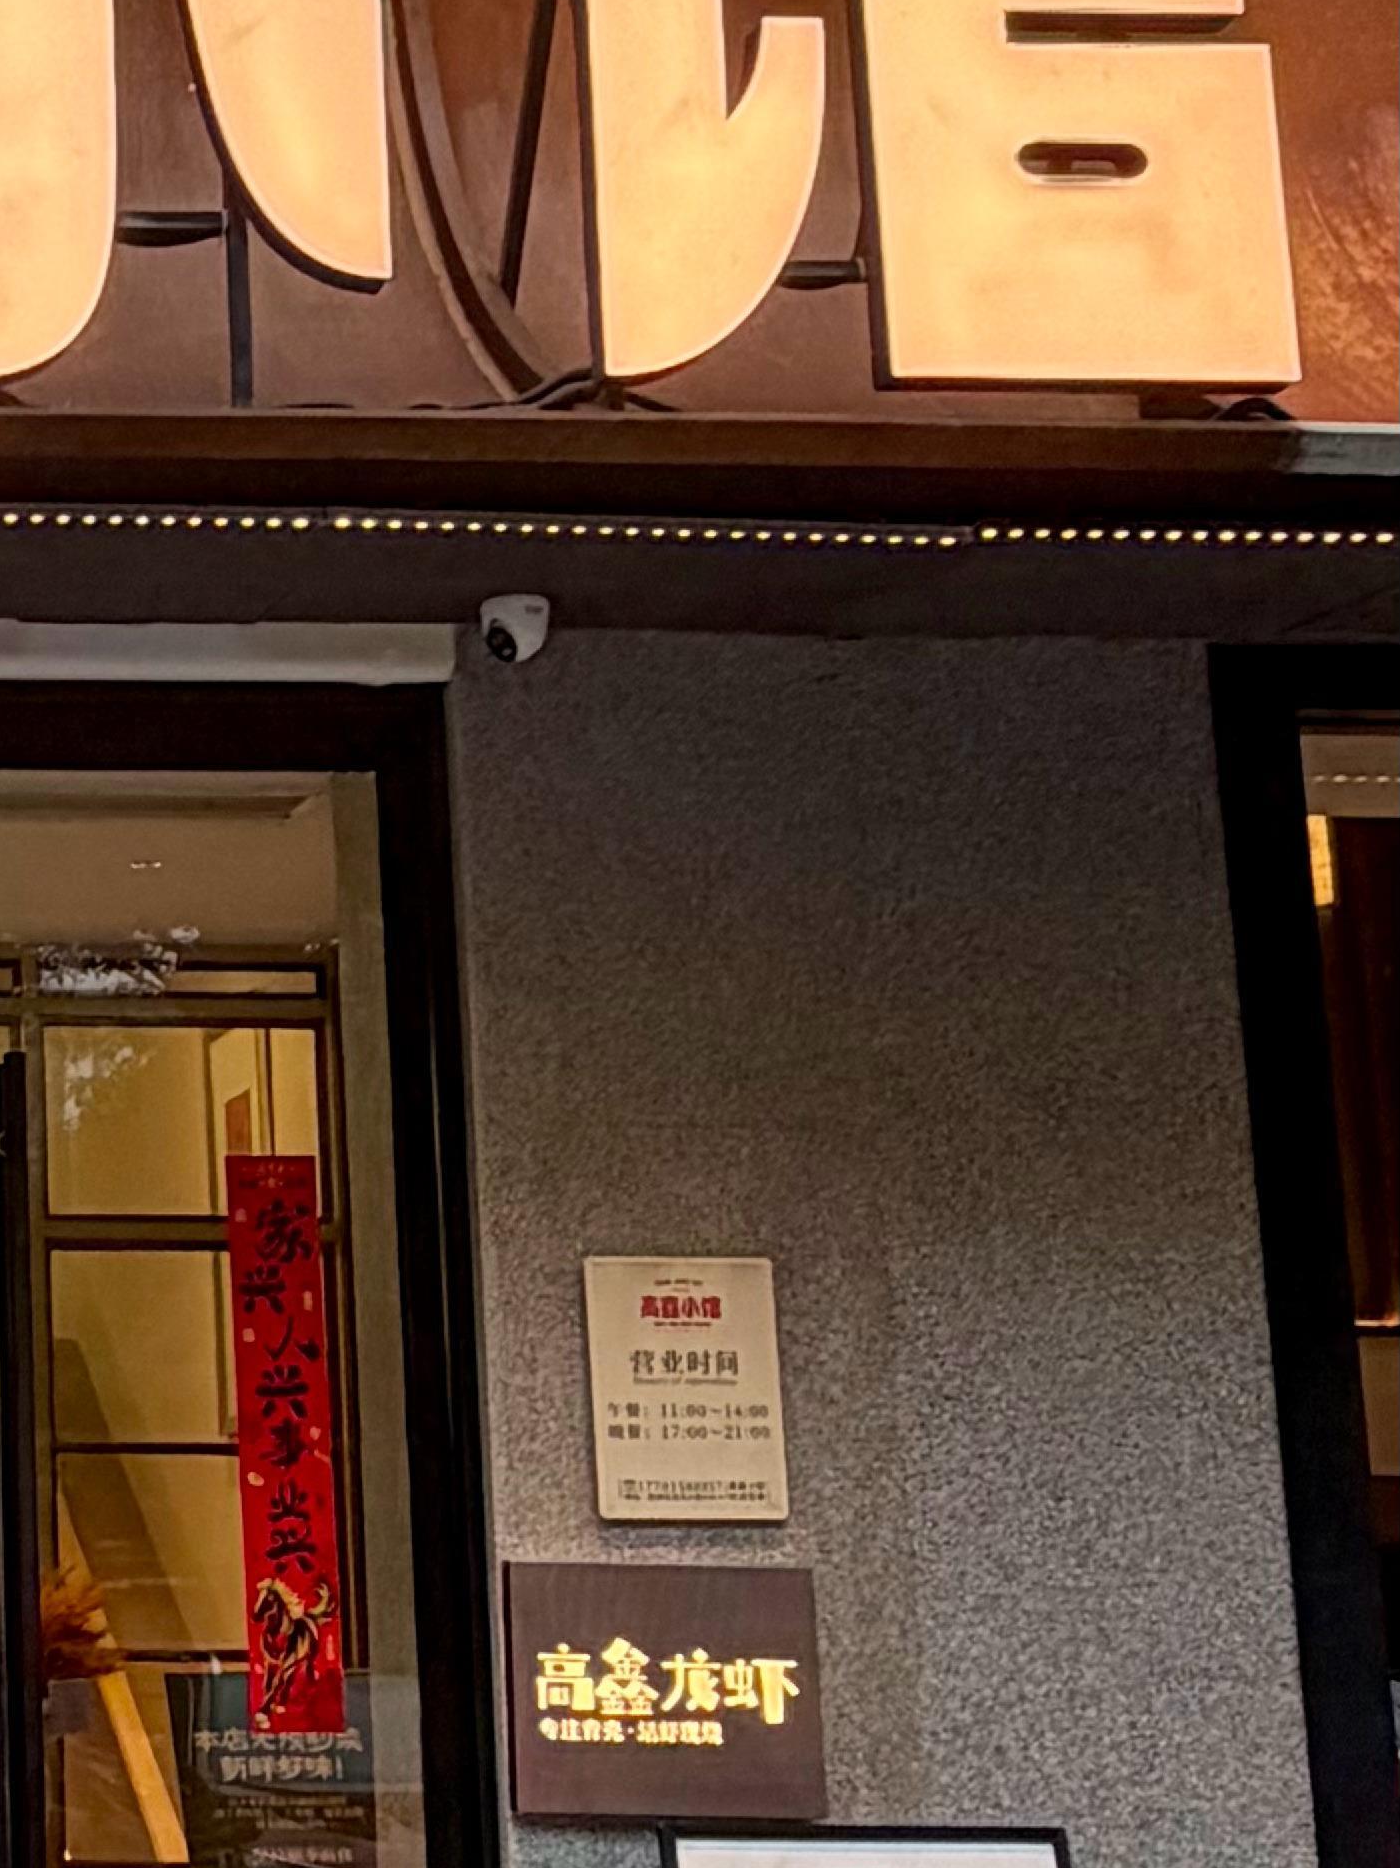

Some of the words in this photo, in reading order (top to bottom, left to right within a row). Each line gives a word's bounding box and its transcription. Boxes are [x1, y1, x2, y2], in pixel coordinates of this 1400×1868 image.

[630, 1348, 740, 1376] 营业时间
[535, 1636, 800, 1725] 高鑫龙虾
